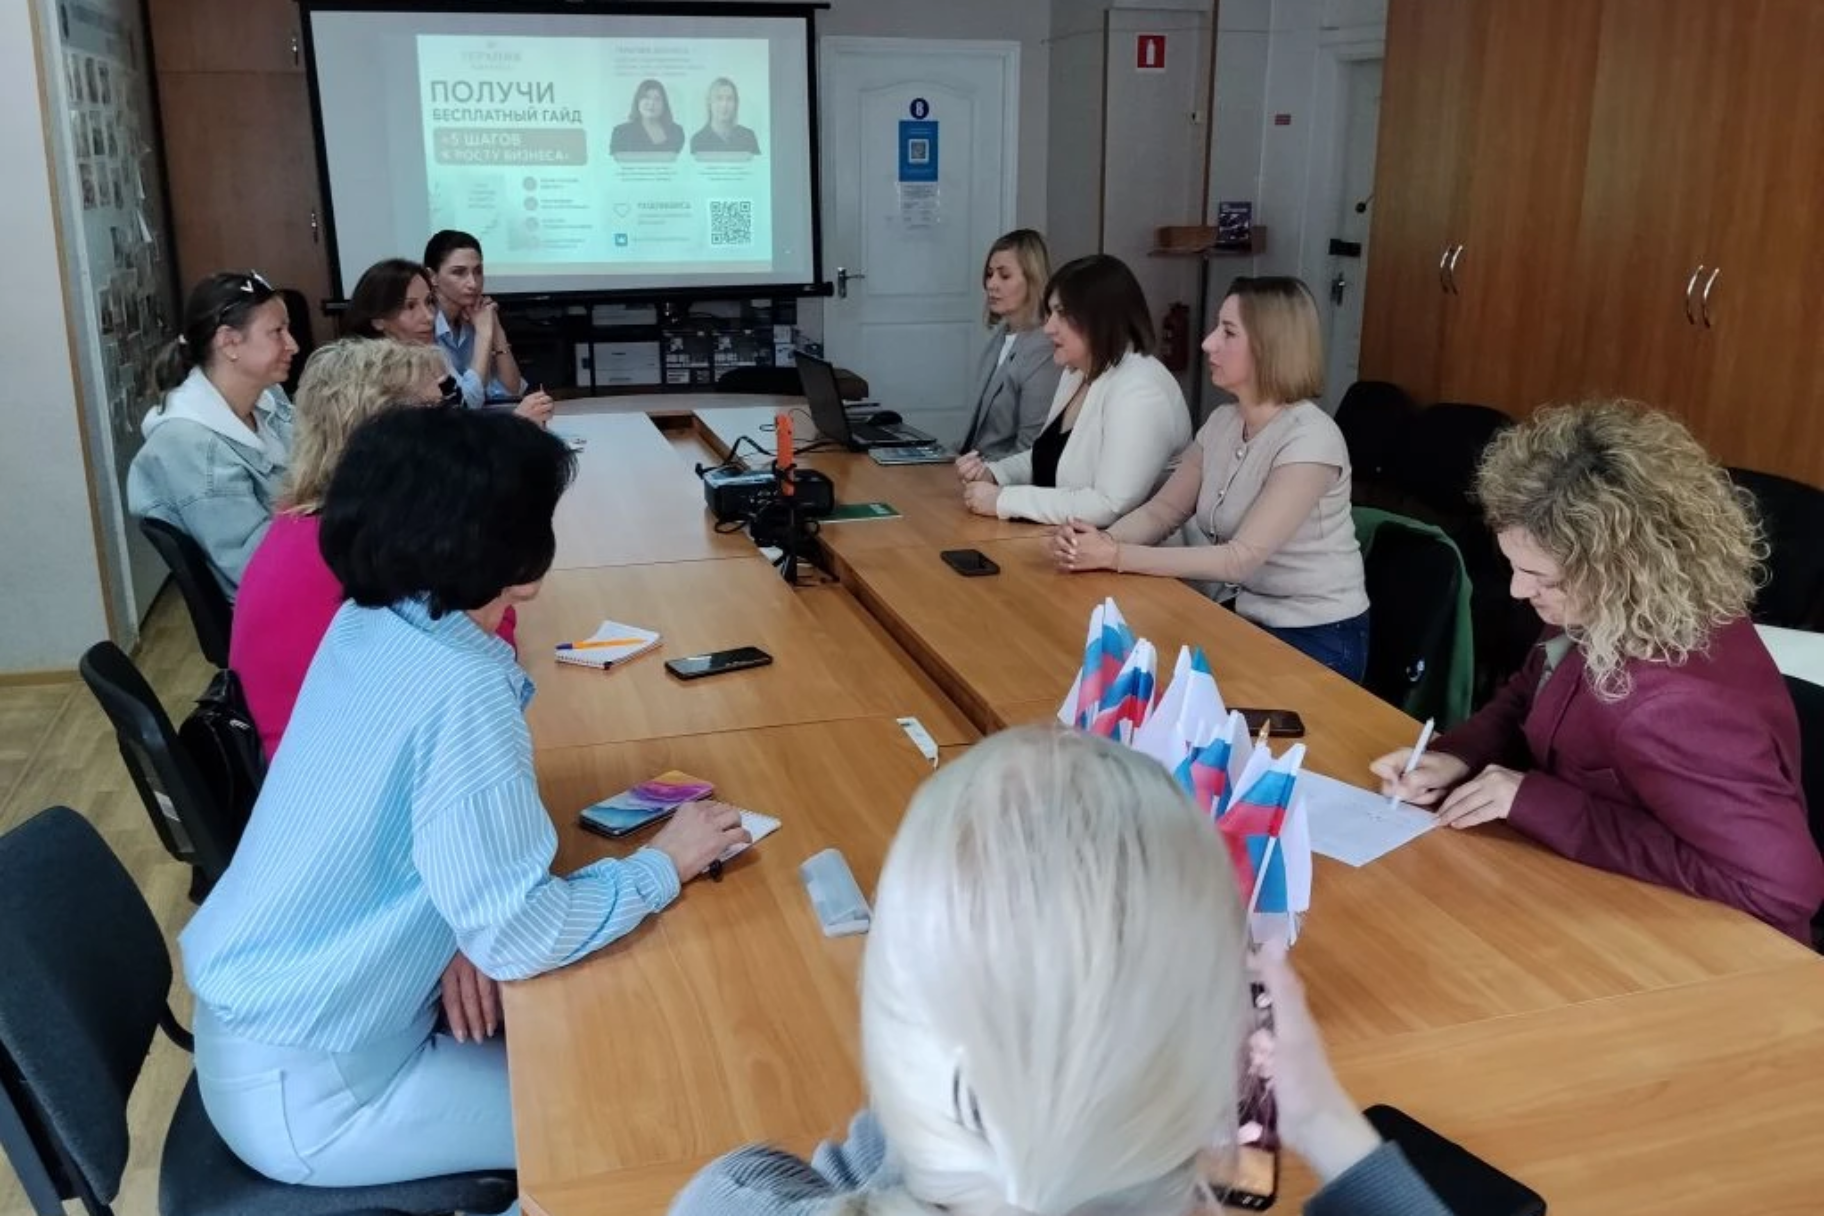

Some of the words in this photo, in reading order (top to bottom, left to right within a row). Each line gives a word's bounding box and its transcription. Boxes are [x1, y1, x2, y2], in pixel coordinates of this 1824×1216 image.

[430, 79, 555, 103] ПОЛУЧИ
[433, 107, 538, 122] БЕСПЛАТНЫЙ
[543, 107, 582, 123] ГАЙД
[464, 132, 522, 146] ШАГОВ
[454, 149, 500, 162] РОСТУ
